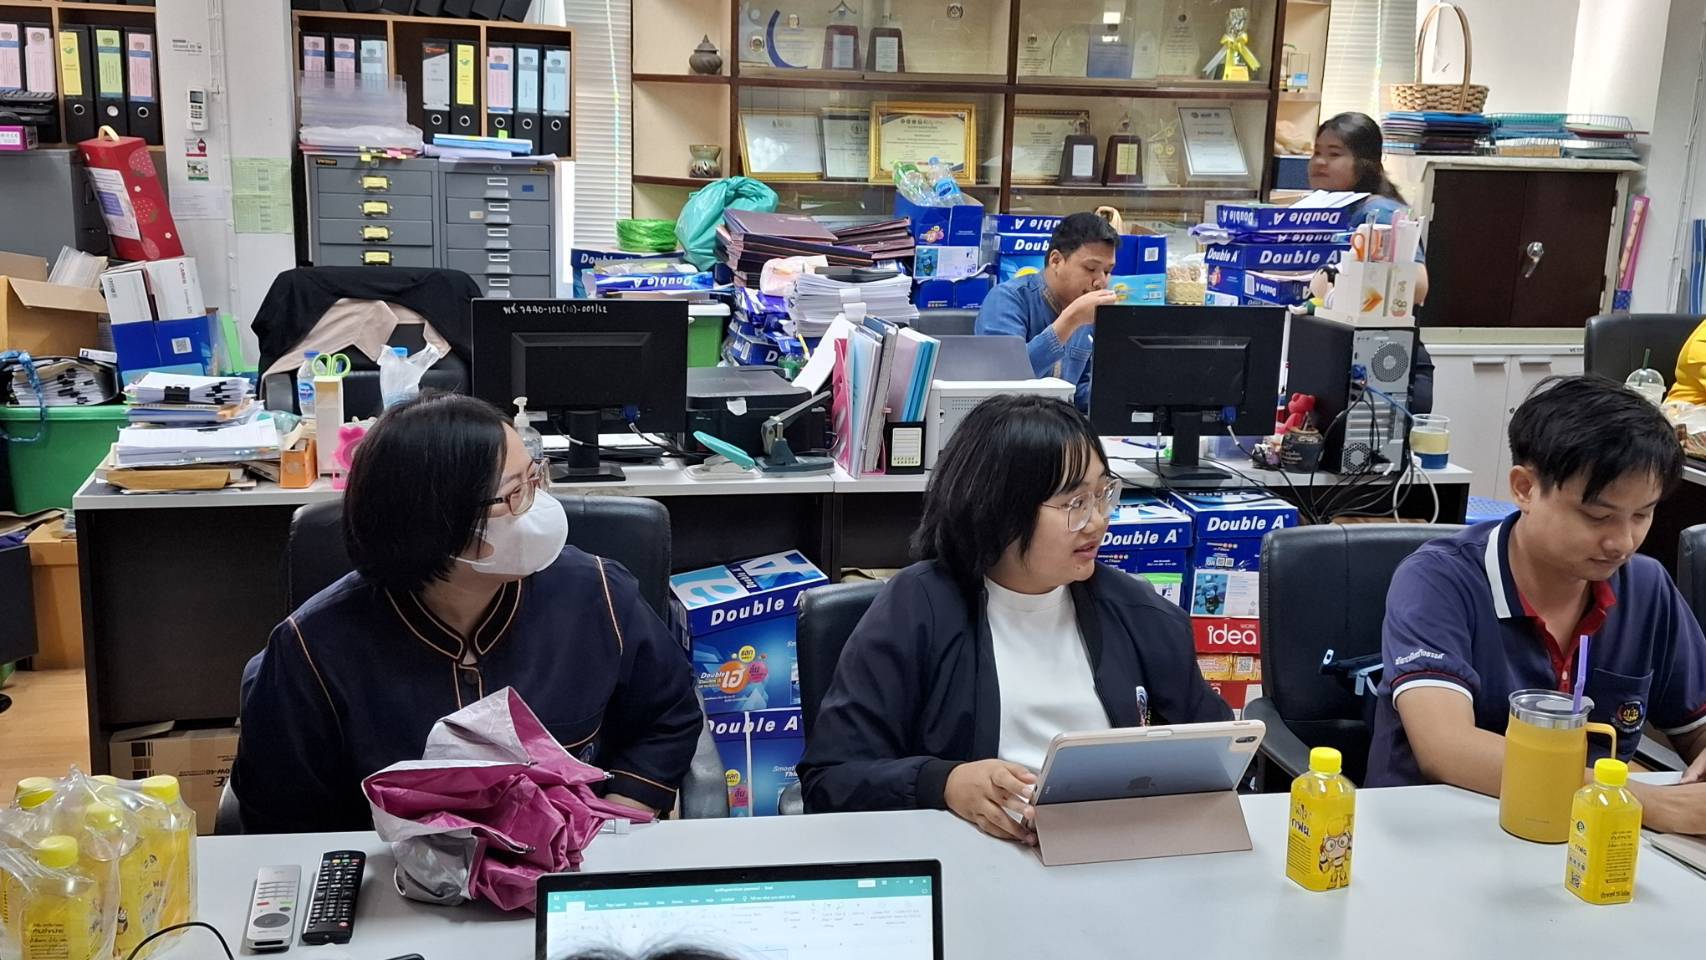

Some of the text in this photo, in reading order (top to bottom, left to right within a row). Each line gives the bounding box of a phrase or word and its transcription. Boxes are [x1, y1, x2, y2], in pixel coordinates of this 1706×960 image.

[1015, 218, 1026, 229] A
[1229, 210, 1254, 225] Double
[1274, 212, 1341, 225] Double A
[1014, 239, 1050, 251] Doub
[1207, 247, 1239, 263] Double A
[1259, 249, 1339, 264] Double A
[634, 277, 692, 288] Double A
[1206, 515, 1285, 531] Double A
[1100, 529, 1178, 546] Double A
[710, 597, 785, 626] Double
[1207, 623, 1257, 645] idea
[783, 715, 798, 731] A
